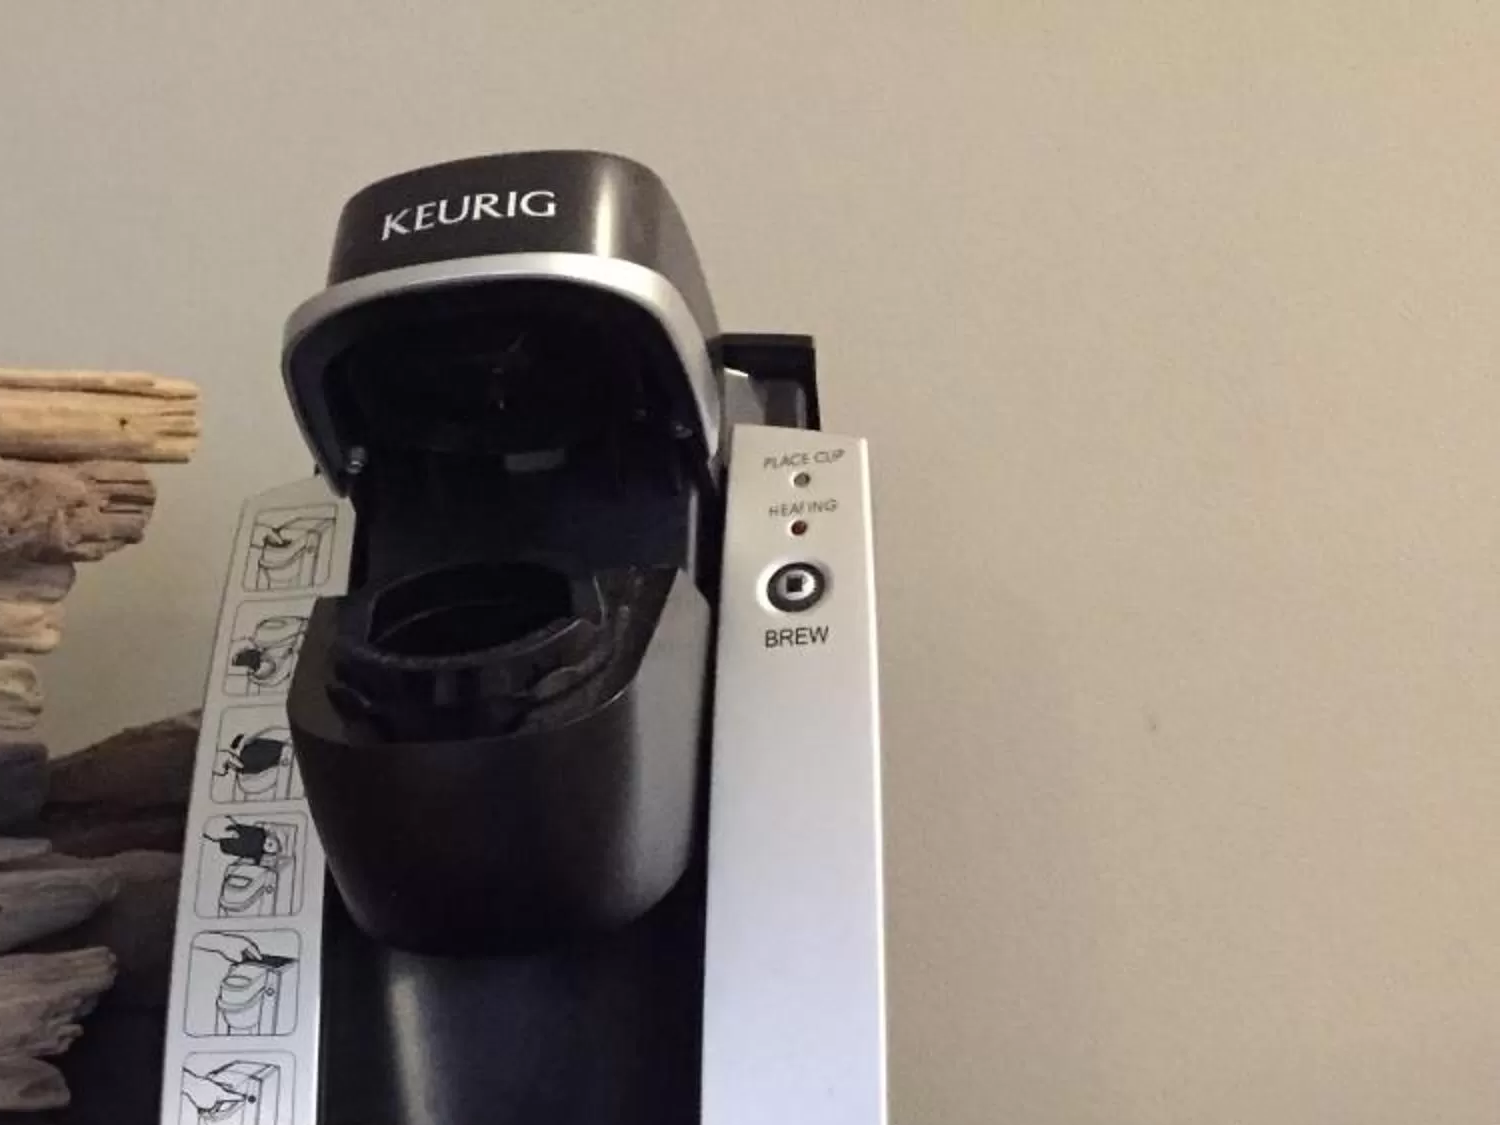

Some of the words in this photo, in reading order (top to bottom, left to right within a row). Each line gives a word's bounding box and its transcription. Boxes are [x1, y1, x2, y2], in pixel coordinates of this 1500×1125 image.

[381, 190, 557, 240] KEURIG
[763, 452, 811, 469] PLACE
[813, 448, 845, 464] CUP
[764, 625, 829, 649] BREW
